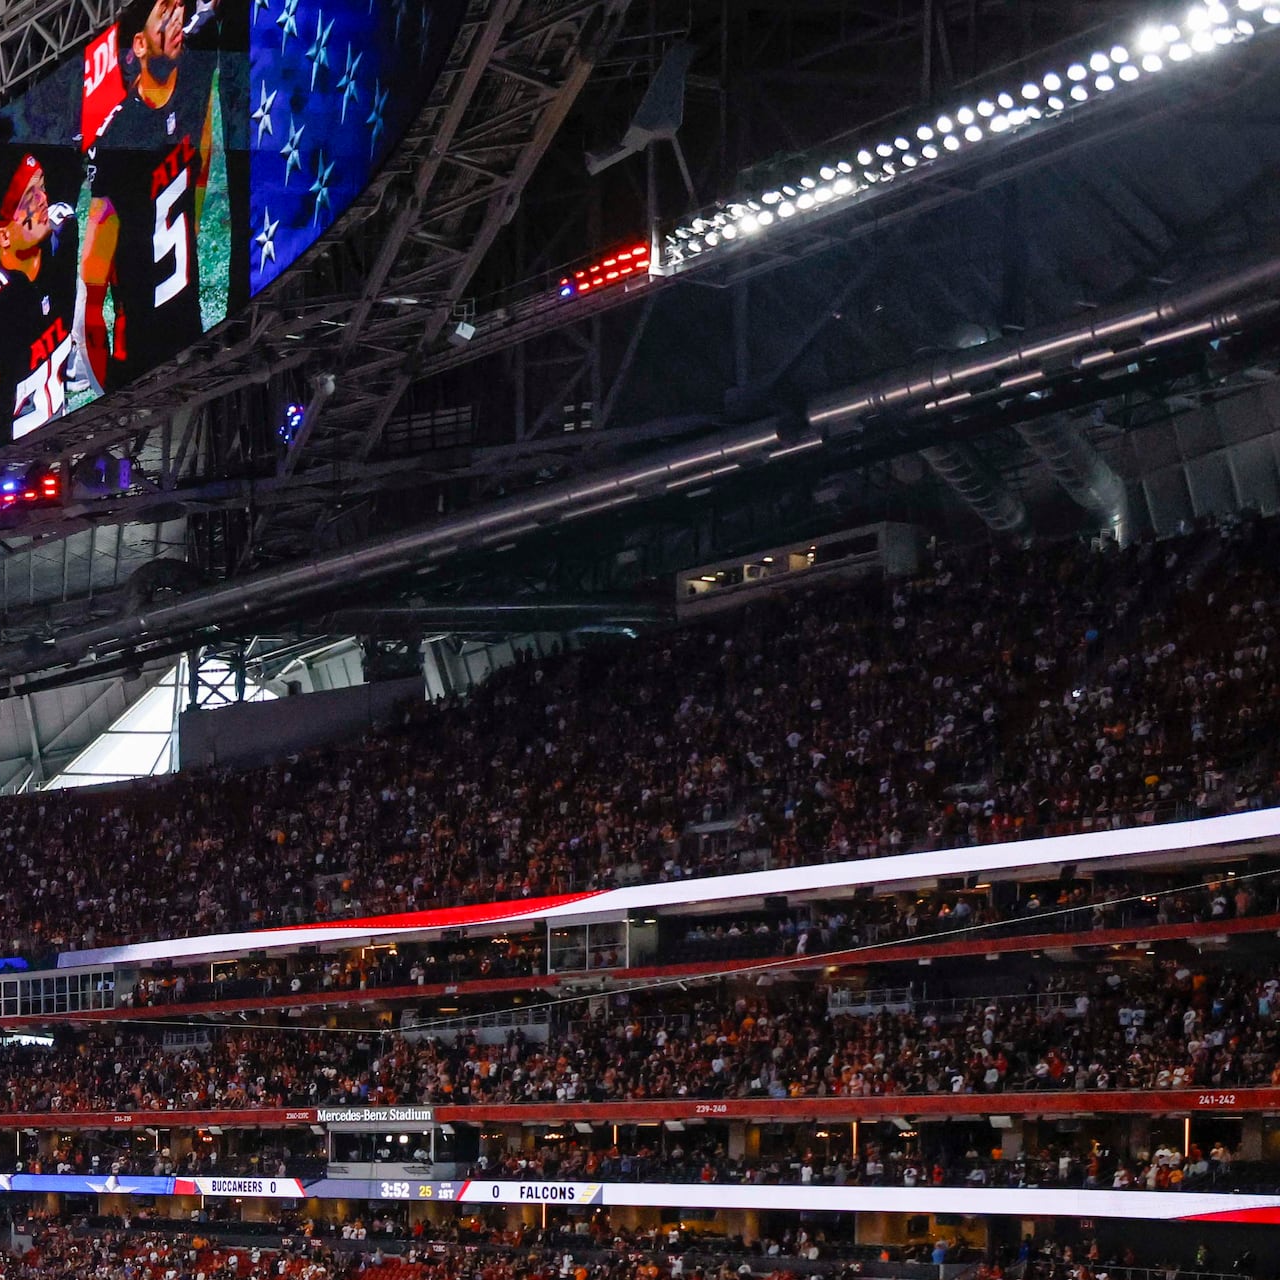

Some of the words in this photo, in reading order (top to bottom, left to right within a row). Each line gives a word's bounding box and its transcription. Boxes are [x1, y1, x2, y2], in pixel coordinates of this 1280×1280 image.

[151, 135, 196, 203] ATL
[153, 167, 190, 308] 5
[30, 317, 67, 371] ATL
[1199, 1095, 1236, 1105] 241-242
[316, 1109, 387, 1123] Mercedes-Benz
[389, 1108, 432, 1122] Stadium
[696, 1105, 727, 1114] 239-240
[211, 1180, 263, 1194] BUCCANEERS
[270, 1181, 277, 1194] 0
[380, 1182, 410, 1198] 3:52
[419, 1185, 433, 1197] 25
[438, 1189, 455, 1199] 1ST
[492, 1186, 500, 1199] 0
[520, 1186, 576, 1200] FALCONS
